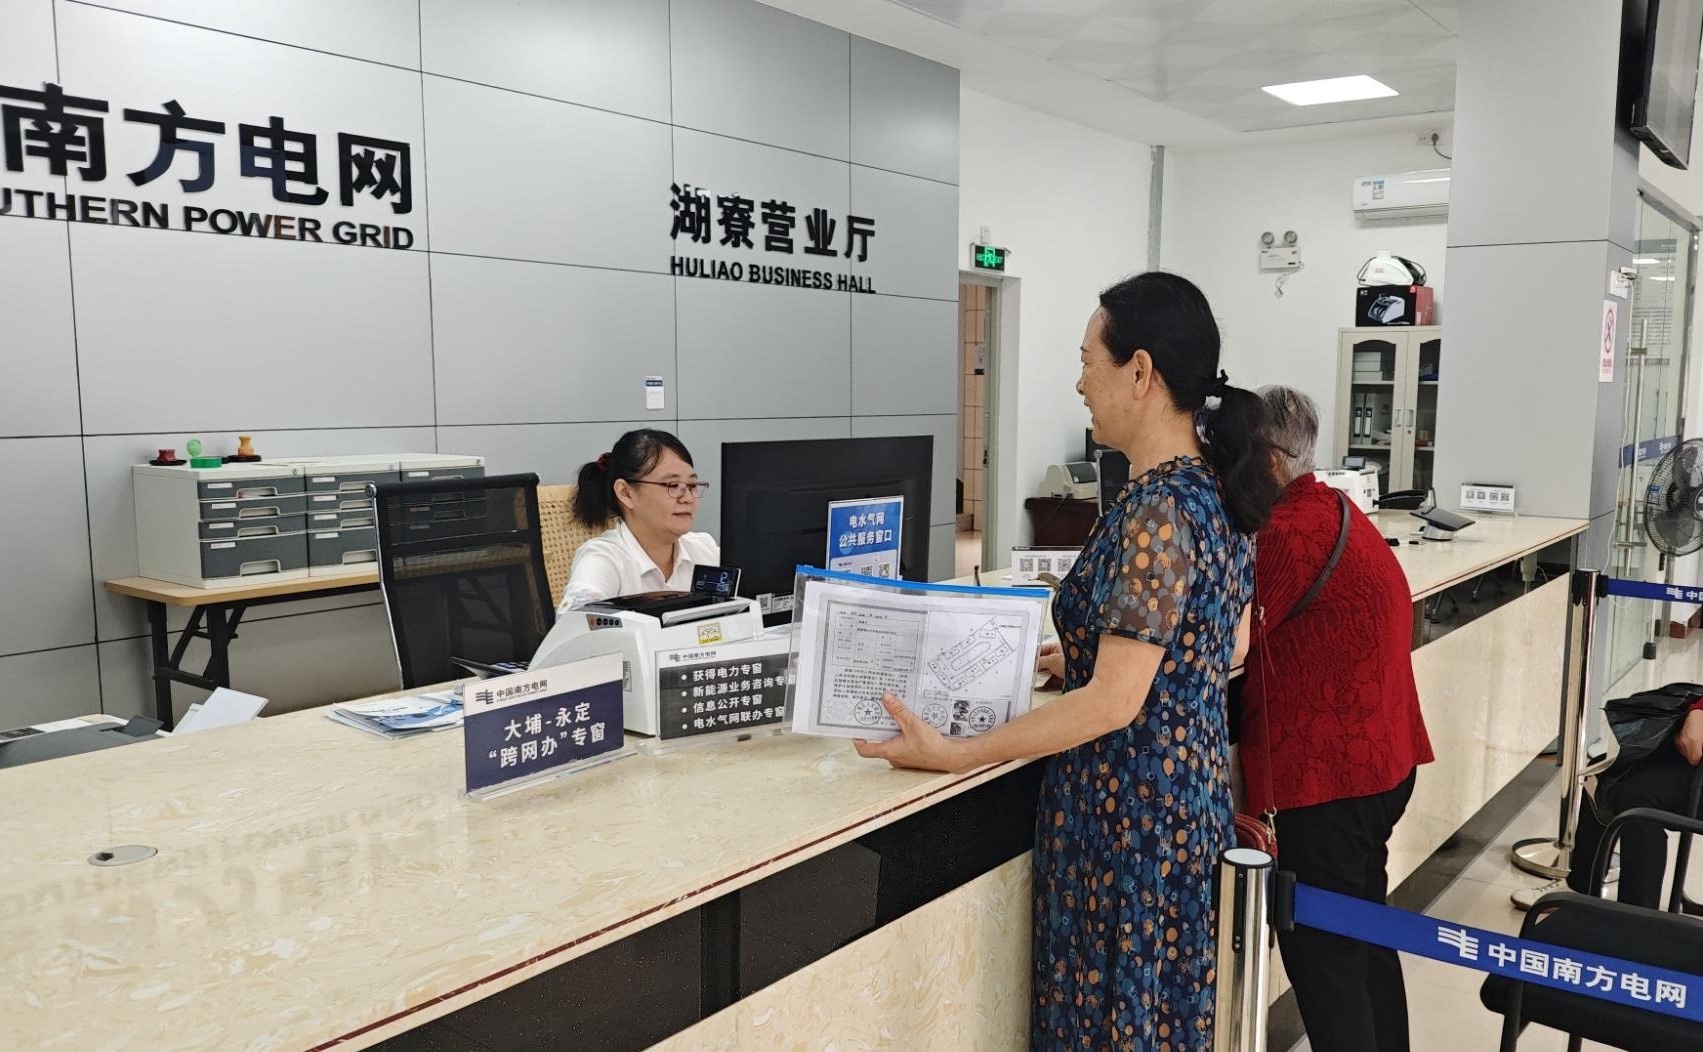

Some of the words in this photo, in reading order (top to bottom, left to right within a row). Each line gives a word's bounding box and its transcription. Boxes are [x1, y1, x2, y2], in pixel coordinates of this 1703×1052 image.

[0, 82, 412, 215] 南方电网
[184, 206, 323, 242] POWER
[332, 221, 414, 250] GRID
[670, 182, 876, 263] 湖寮营业厅
[670, 256, 744, 281] HULIAO
[748, 264, 833, 290] BUSINESS
[838, 273, 876, 294] HALL
[849, 512, 885, 528] 电水气网
[839, 530, 892, 548] 公共服务窗口
[693, 663, 762, 681] 获得电力专窗
[497, 680, 548, 698] 中国南方电网
[693, 694, 762, 713] 信息公开专窗
[693, 706, 785, 729] 电水气网联办专窗
[1488, 943, 1688, 1009] 中国南方电网
